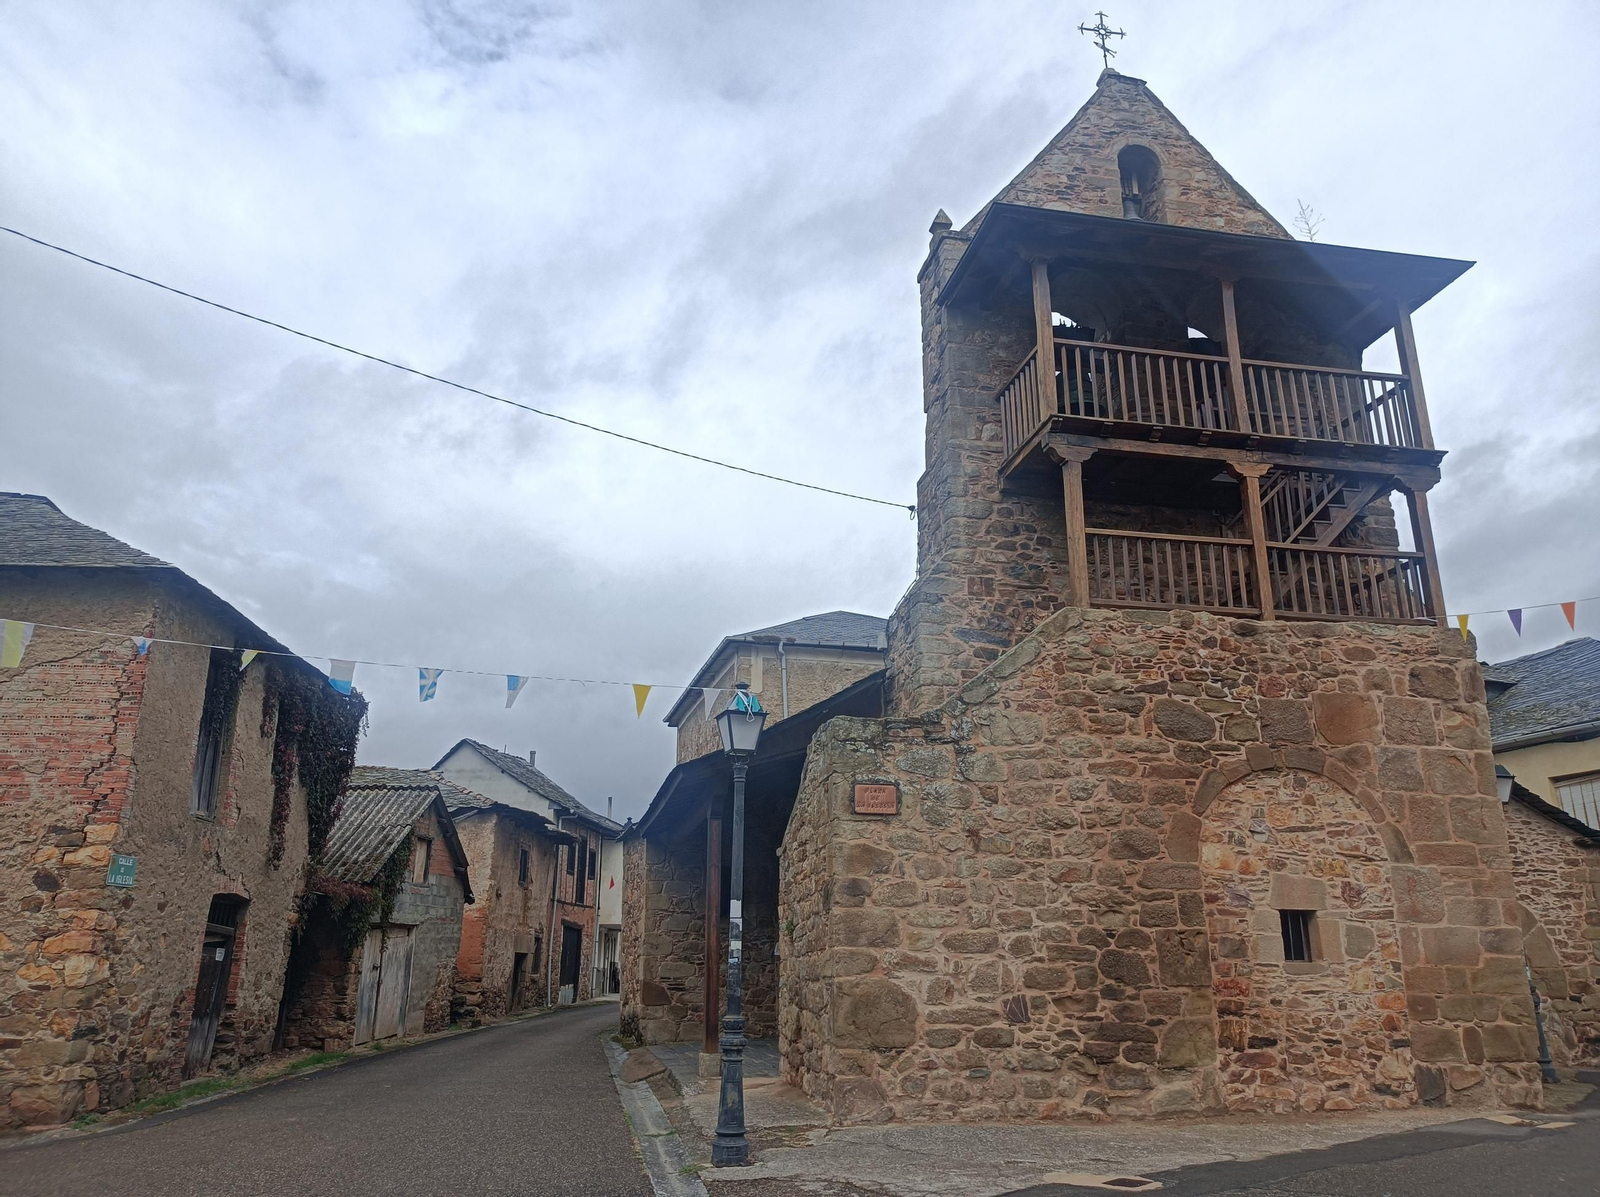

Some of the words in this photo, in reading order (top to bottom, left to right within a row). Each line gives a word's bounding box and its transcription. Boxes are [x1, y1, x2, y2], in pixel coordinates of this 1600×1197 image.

[118, 857, 134, 866] CALLE
[108, 874, 115, 883] LA
[115, 874, 133, 885] IGLESIA
